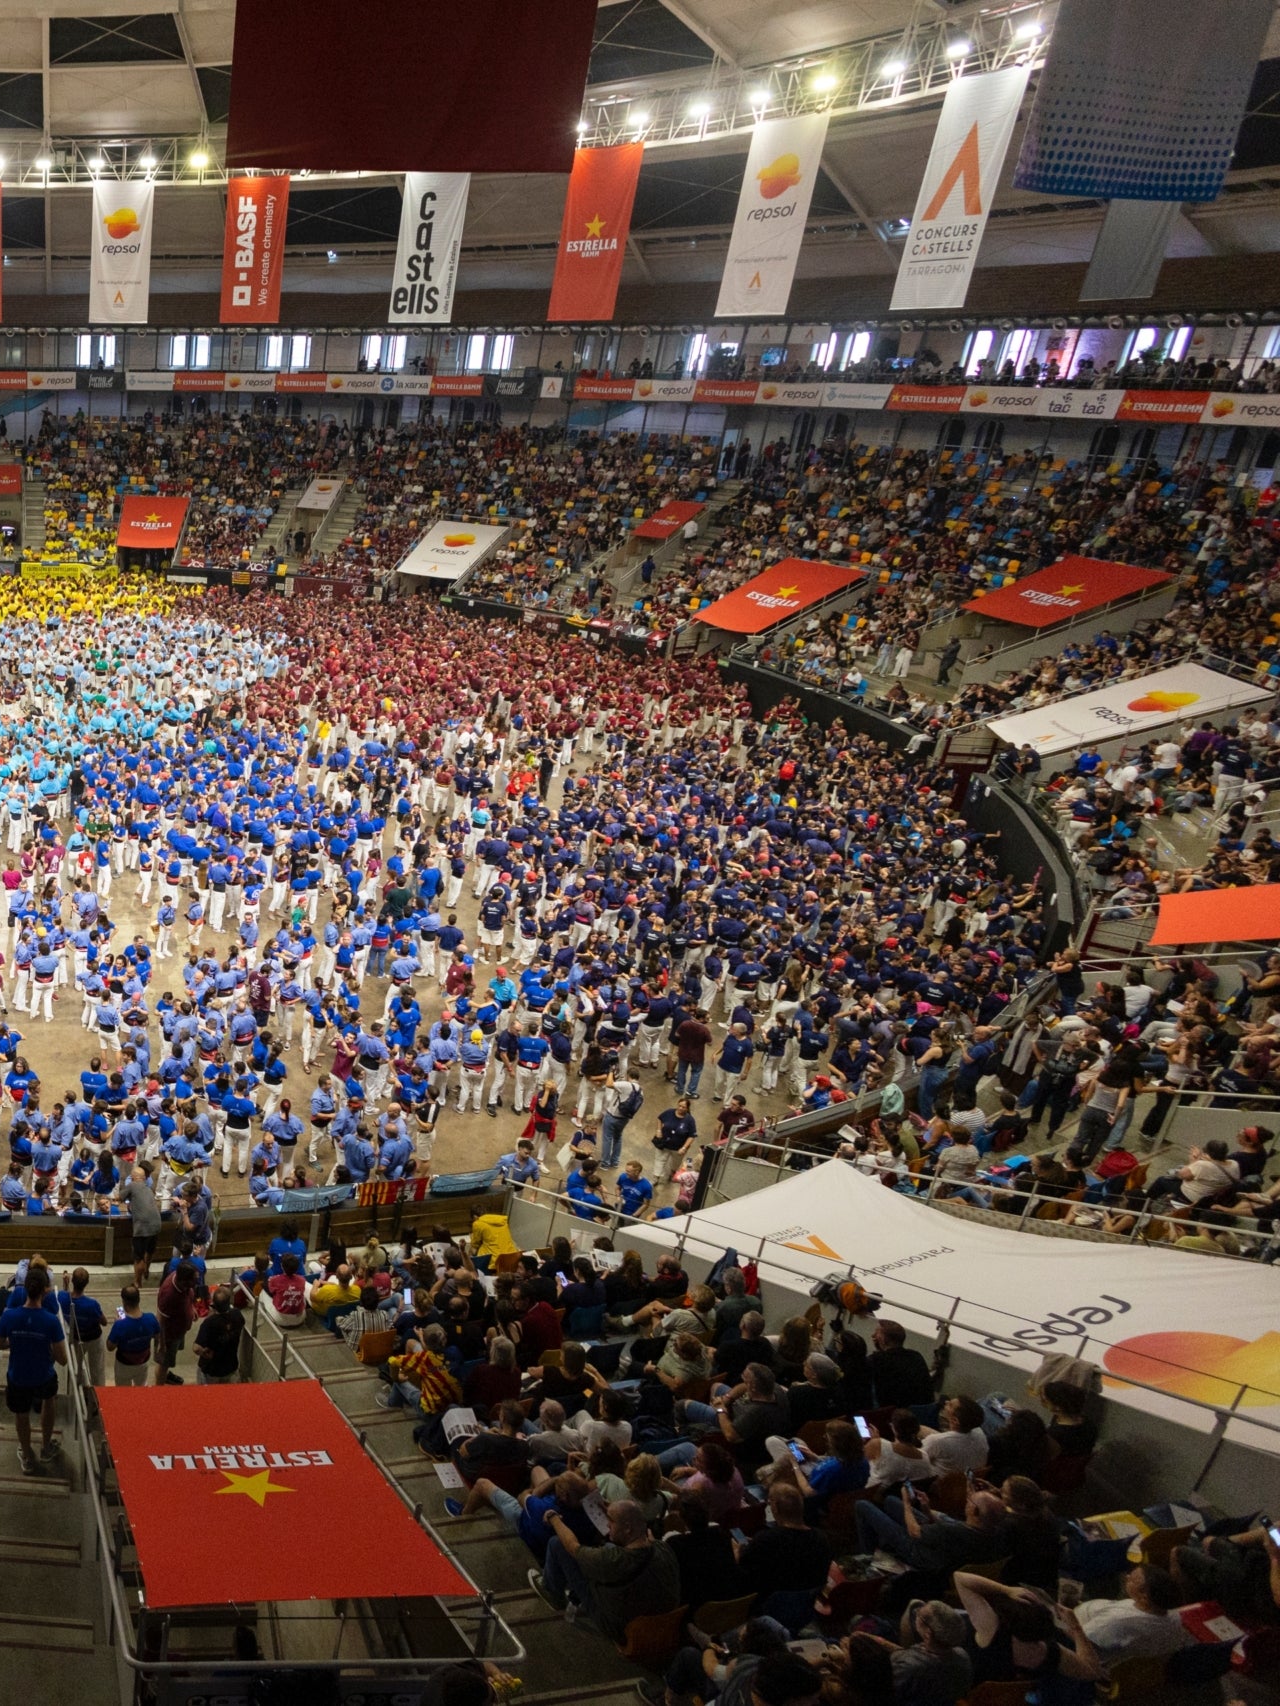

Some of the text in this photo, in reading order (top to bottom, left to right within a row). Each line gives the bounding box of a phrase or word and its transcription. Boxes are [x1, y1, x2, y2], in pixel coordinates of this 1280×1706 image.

[747, 202, 797, 223] repsol
[235, 196, 258, 269] BASF
[915, 223, 978, 241] CONCURS
[102, 243, 141, 256] repsol
[257, 194, 277, 306] We create chemistry
[566, 238, 618, 252] ESTRELLA
[911, 239, 973, 256] CASTELLS
[905, 263, 967, 277] TARRAGONA
[46, 376, 74, 386] repsol
[244, 378, 273, 388] repsol
[346, 379, 376, 389] repsol
[395, 380, 429, 389] la xarxa
[657, 385, 692, 396] repsol
[782, 388, 819, 401] repsol
[901, 395, 933, 403] ESTRELLA
[992, 395, 1036, 408] repsol
[1048, 400, 1071, 414] tac
[1081, 400, 1105, 415] tac
[1132, 402, 1173, 412] ESTRELLA
[430, 547, 469, 556] repsol
[745, 590, 800, 607] ESTRELLA
[203, 1444, 267, 1454] DAMM
[148, 1450, 335, 1470] ESTRELLA
